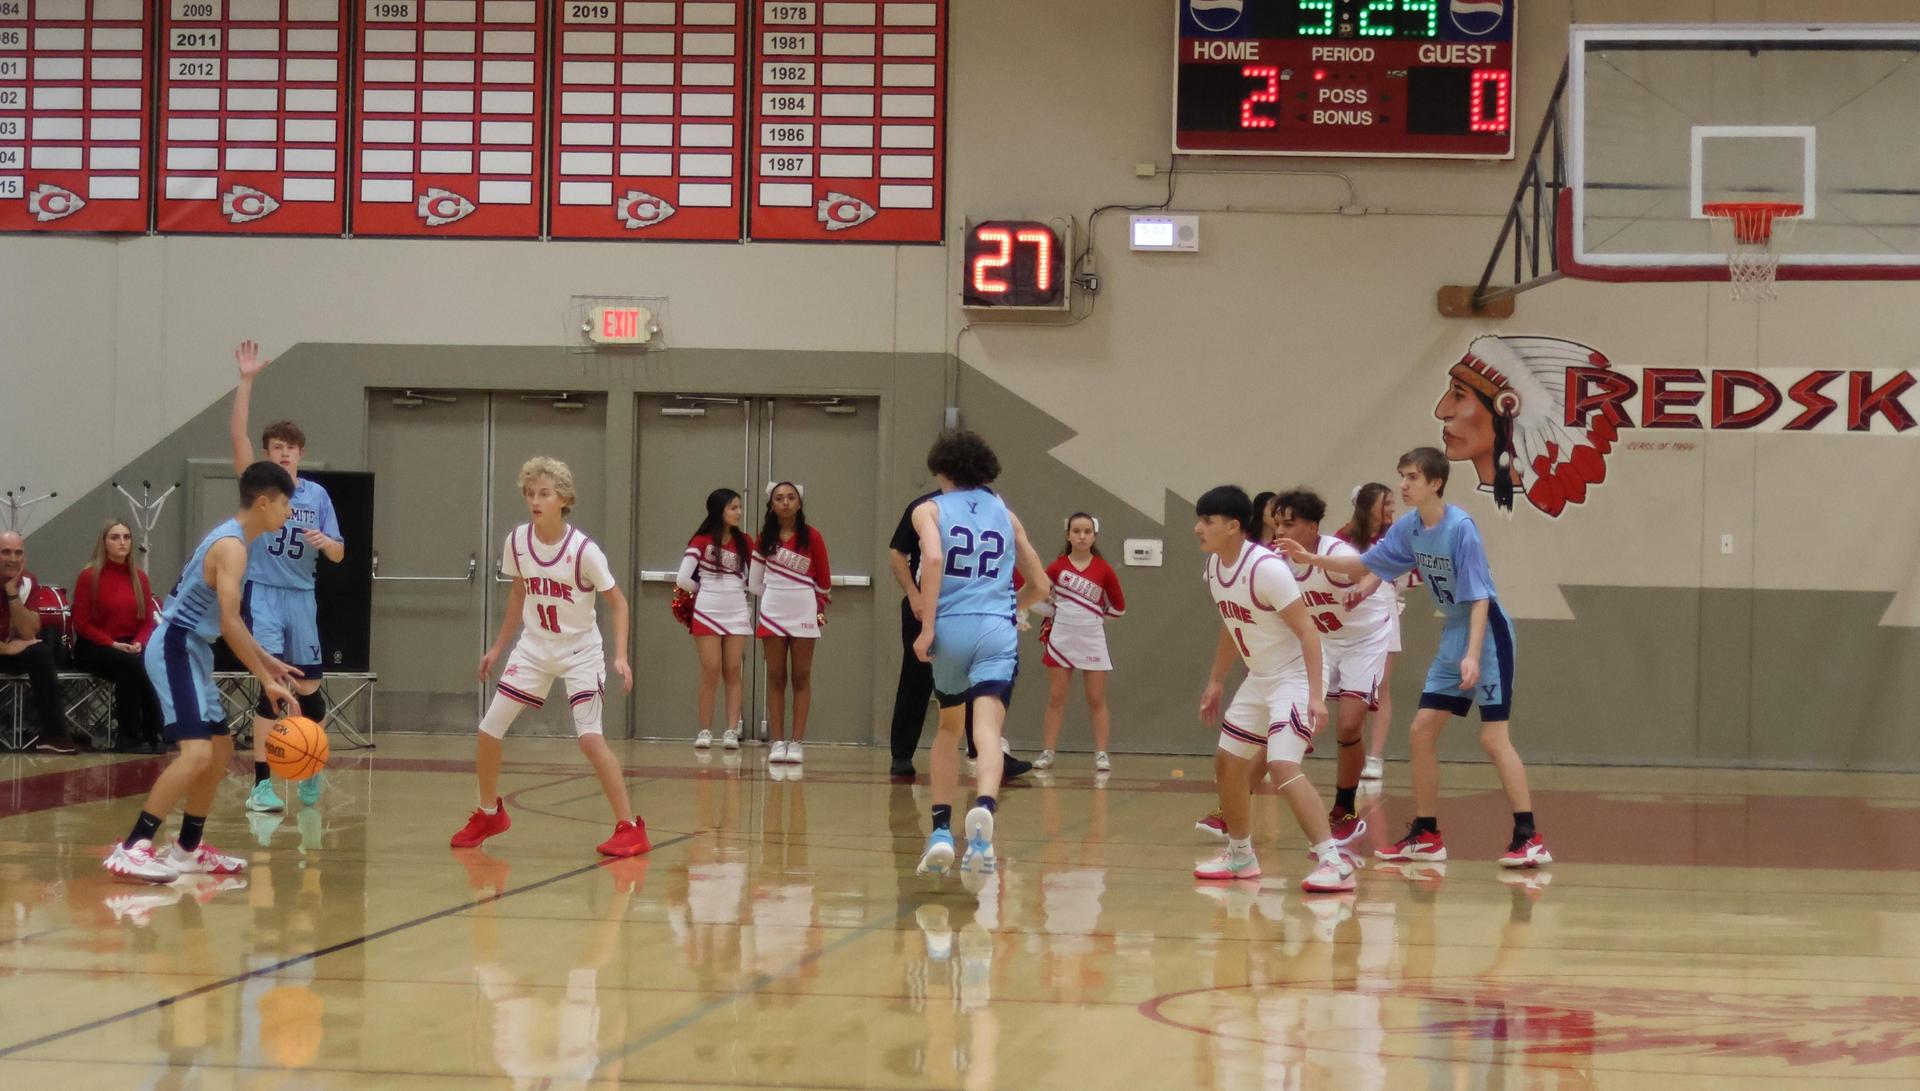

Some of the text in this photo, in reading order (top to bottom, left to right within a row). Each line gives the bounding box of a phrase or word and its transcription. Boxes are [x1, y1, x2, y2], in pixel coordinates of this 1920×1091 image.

[0, 2, 20, 16] 84
[182, 3, 213, 17] 2009
[373, 4, 409, 18] 1998
[572, 5, 609, 19] 2019
[771, 6, 807, 21] 1978
[0, 31, 20, 45] 86
[176, 33, 217, 47] 2011
[770, 36, 806, 50] 1981
[1193, 41, 1260, 60] HOME
[1311, 46, 1375, 62] PERIOD
[1418, 44, 1497, 64] GUEST
[178, 62, 214, 76] 2012
[770, 66, 806, 81] 1982
[769, 96, 806, 111] 1984
[1240, 65, 1279, 128] 2
[1319, 88, 1368, 104] POSS
[1470, 69, 1509, 132] 0
[1313, 110, 1373, 126] BONUS
[769, 128, 805, 142] 1986
[768, 157, 804, 172] 1987
[972, 227, 1051, 293] 27
[603, 310, 640, 338] EXIT
[1564, 366, 1919, 432] REDSK
[287, 508, 316, 524] MITE
[267, 525, 305, 560] 35
[944, 524, 1006, 580] 22
[536, 603, 562, 634] 11
[1234, 627, 1251, 657] 1
[309, 645, 320, 661] Y
[1482, 685, 1497, 701] Y
